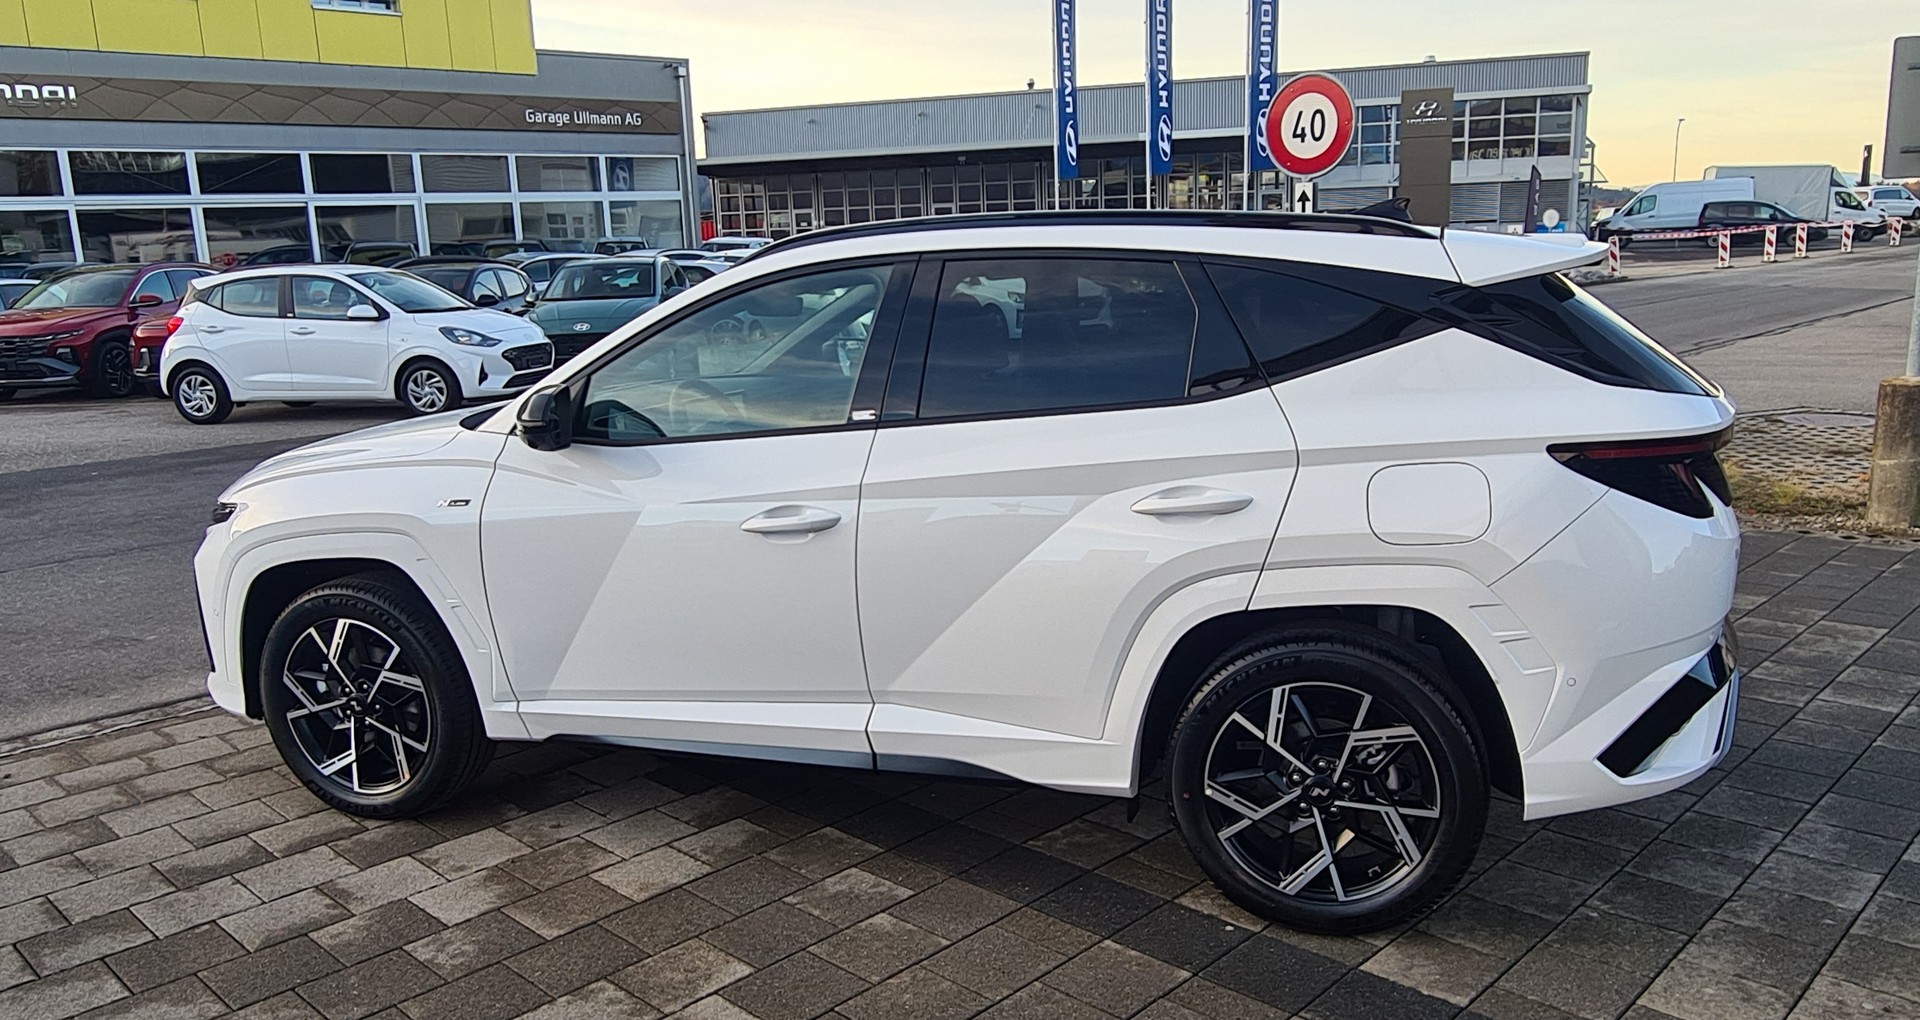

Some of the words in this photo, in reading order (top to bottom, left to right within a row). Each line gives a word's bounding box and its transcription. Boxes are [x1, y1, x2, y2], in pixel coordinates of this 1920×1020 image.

[1258, 0, 1272, 101] HYUND
[525, 109, 571, 127] Garage
[573, 110, 622, 125] Ullmann
[625, 112, 642, 126] AG
[1291, 108, 1326, 144] 40
